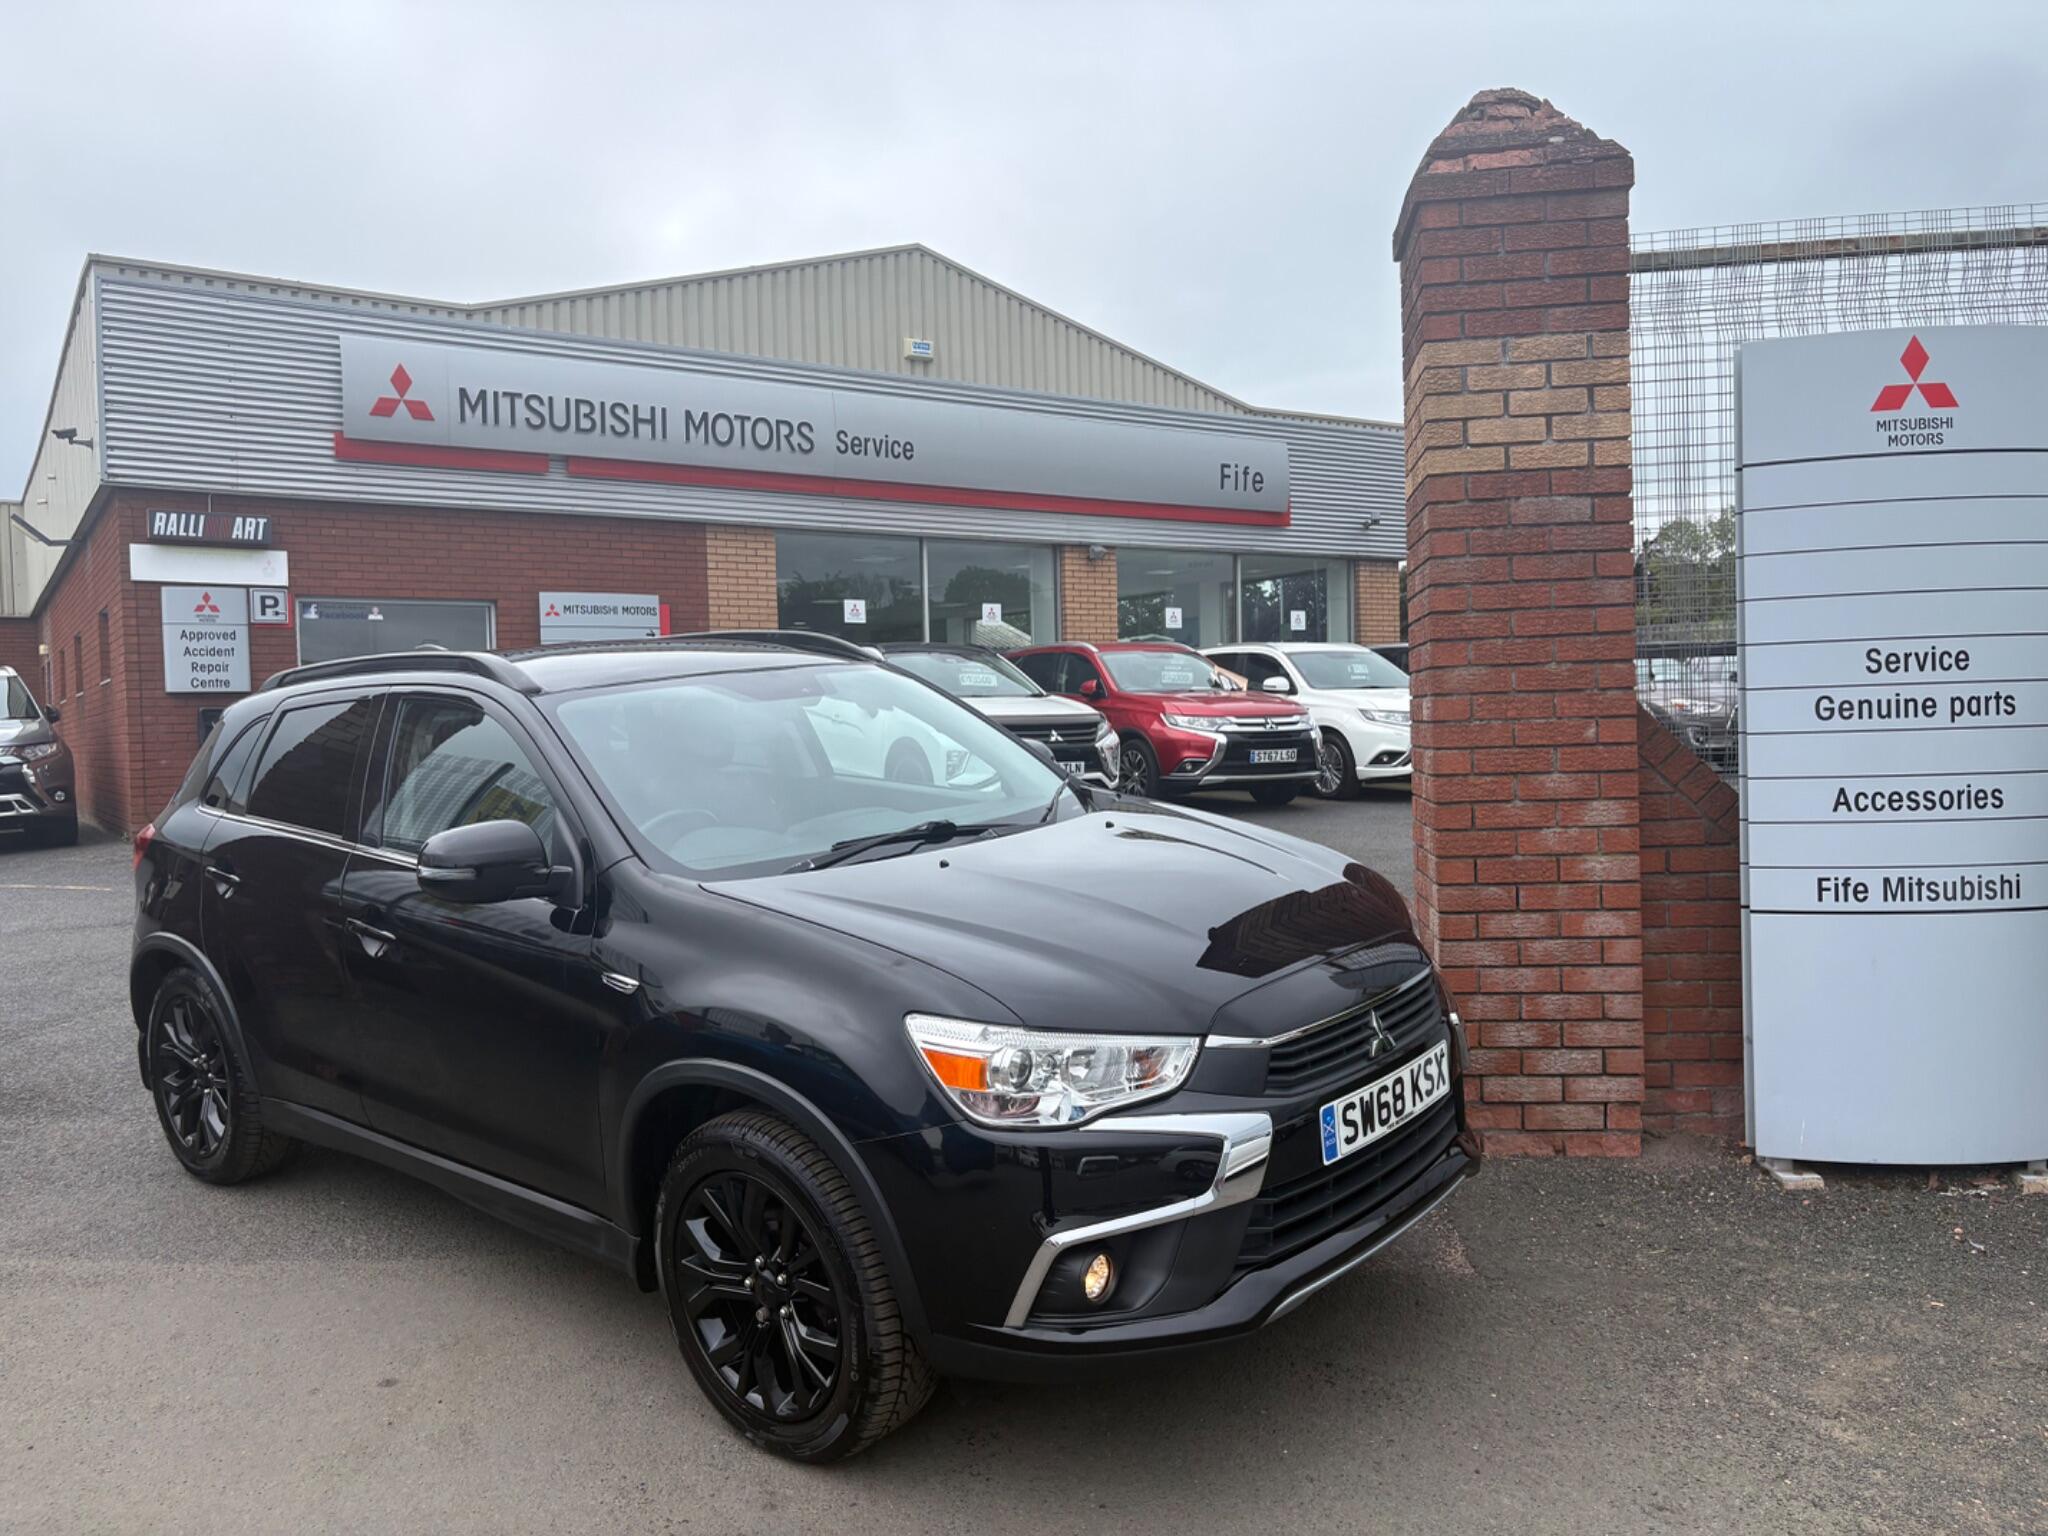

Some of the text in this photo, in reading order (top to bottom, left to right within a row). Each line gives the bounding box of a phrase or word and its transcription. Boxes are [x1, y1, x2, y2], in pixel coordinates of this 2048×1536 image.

[457, 386, 916, 461] MITSUBISHI MOTORS Service
[1876, 416, 1954, 433] MITSUBISHI
[1887, 432, 1944, 447] MOTORS
[1220, 463, 1264, 493] Fife
[153, 511, 268, 541] RALLI ART
[259, 594, 279, 617] P
[563, 604, 658, 617] MITSUBISHI MOTORS
[180, 629, 237, 642] Approved
[183, 646, 235, 658] Accident
[1865, 646, 1971, 674] Service
[191, 661, 230, 675] Repair
[190, 677, 231, 689] Centre
[1814, 690, 2017, 723] Genuine parts
[1832, 783, 2005, 813] Accessories
[1816, 873, 2021, 903] Fife Mitsubishi
[1340, 1050, 1447, 1146] SW68 KSX
